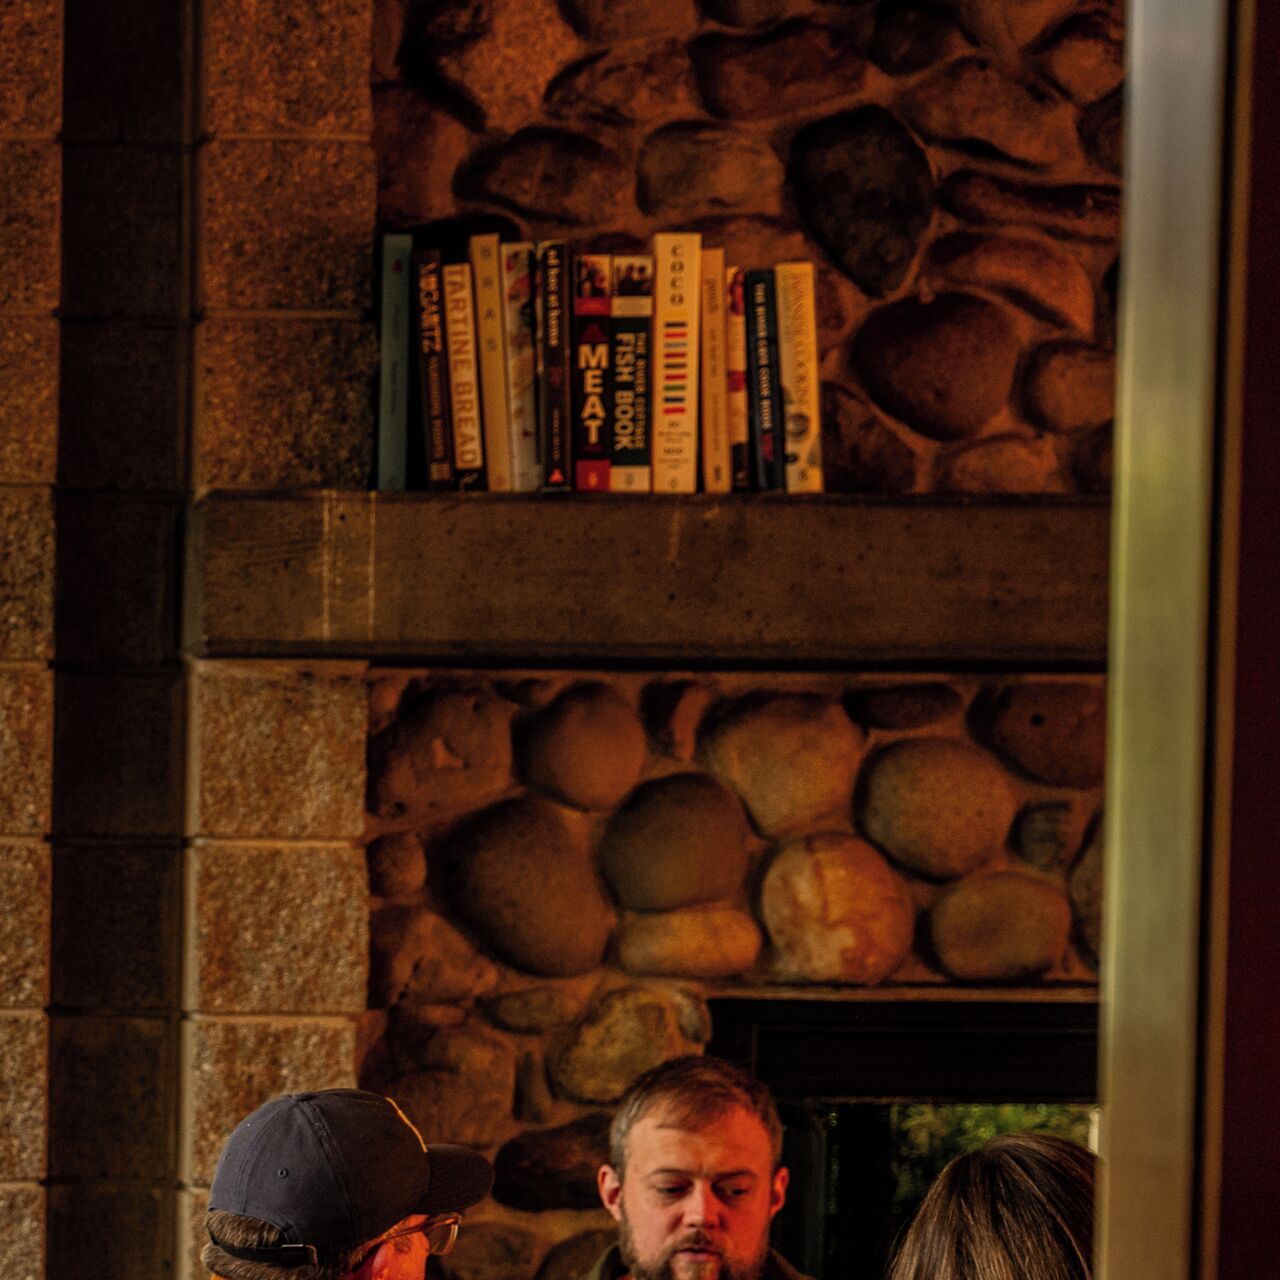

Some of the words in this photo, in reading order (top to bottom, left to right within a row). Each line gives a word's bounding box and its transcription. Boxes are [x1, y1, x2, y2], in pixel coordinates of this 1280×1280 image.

[670, 244, 685, 305] COCO
[752, 282, 766, 303] THE
[445, 266, 470, 372] TARTINE
[547, 309, 561, 347] home
[635, 331, 647, 356] THE
[615, 332, 635, 382] FISH
[634, 358, 646, 394] RIVER
[759, 366, 772, 397] COOK
[578, 343, 609, 445] MEAT
[761, 398, 775, 429] BOOK
[453, 381, 479, 465] BREAD
[614, 389, 635, 452] BOOK
[634, 397, 646, 450] COTTAGE
